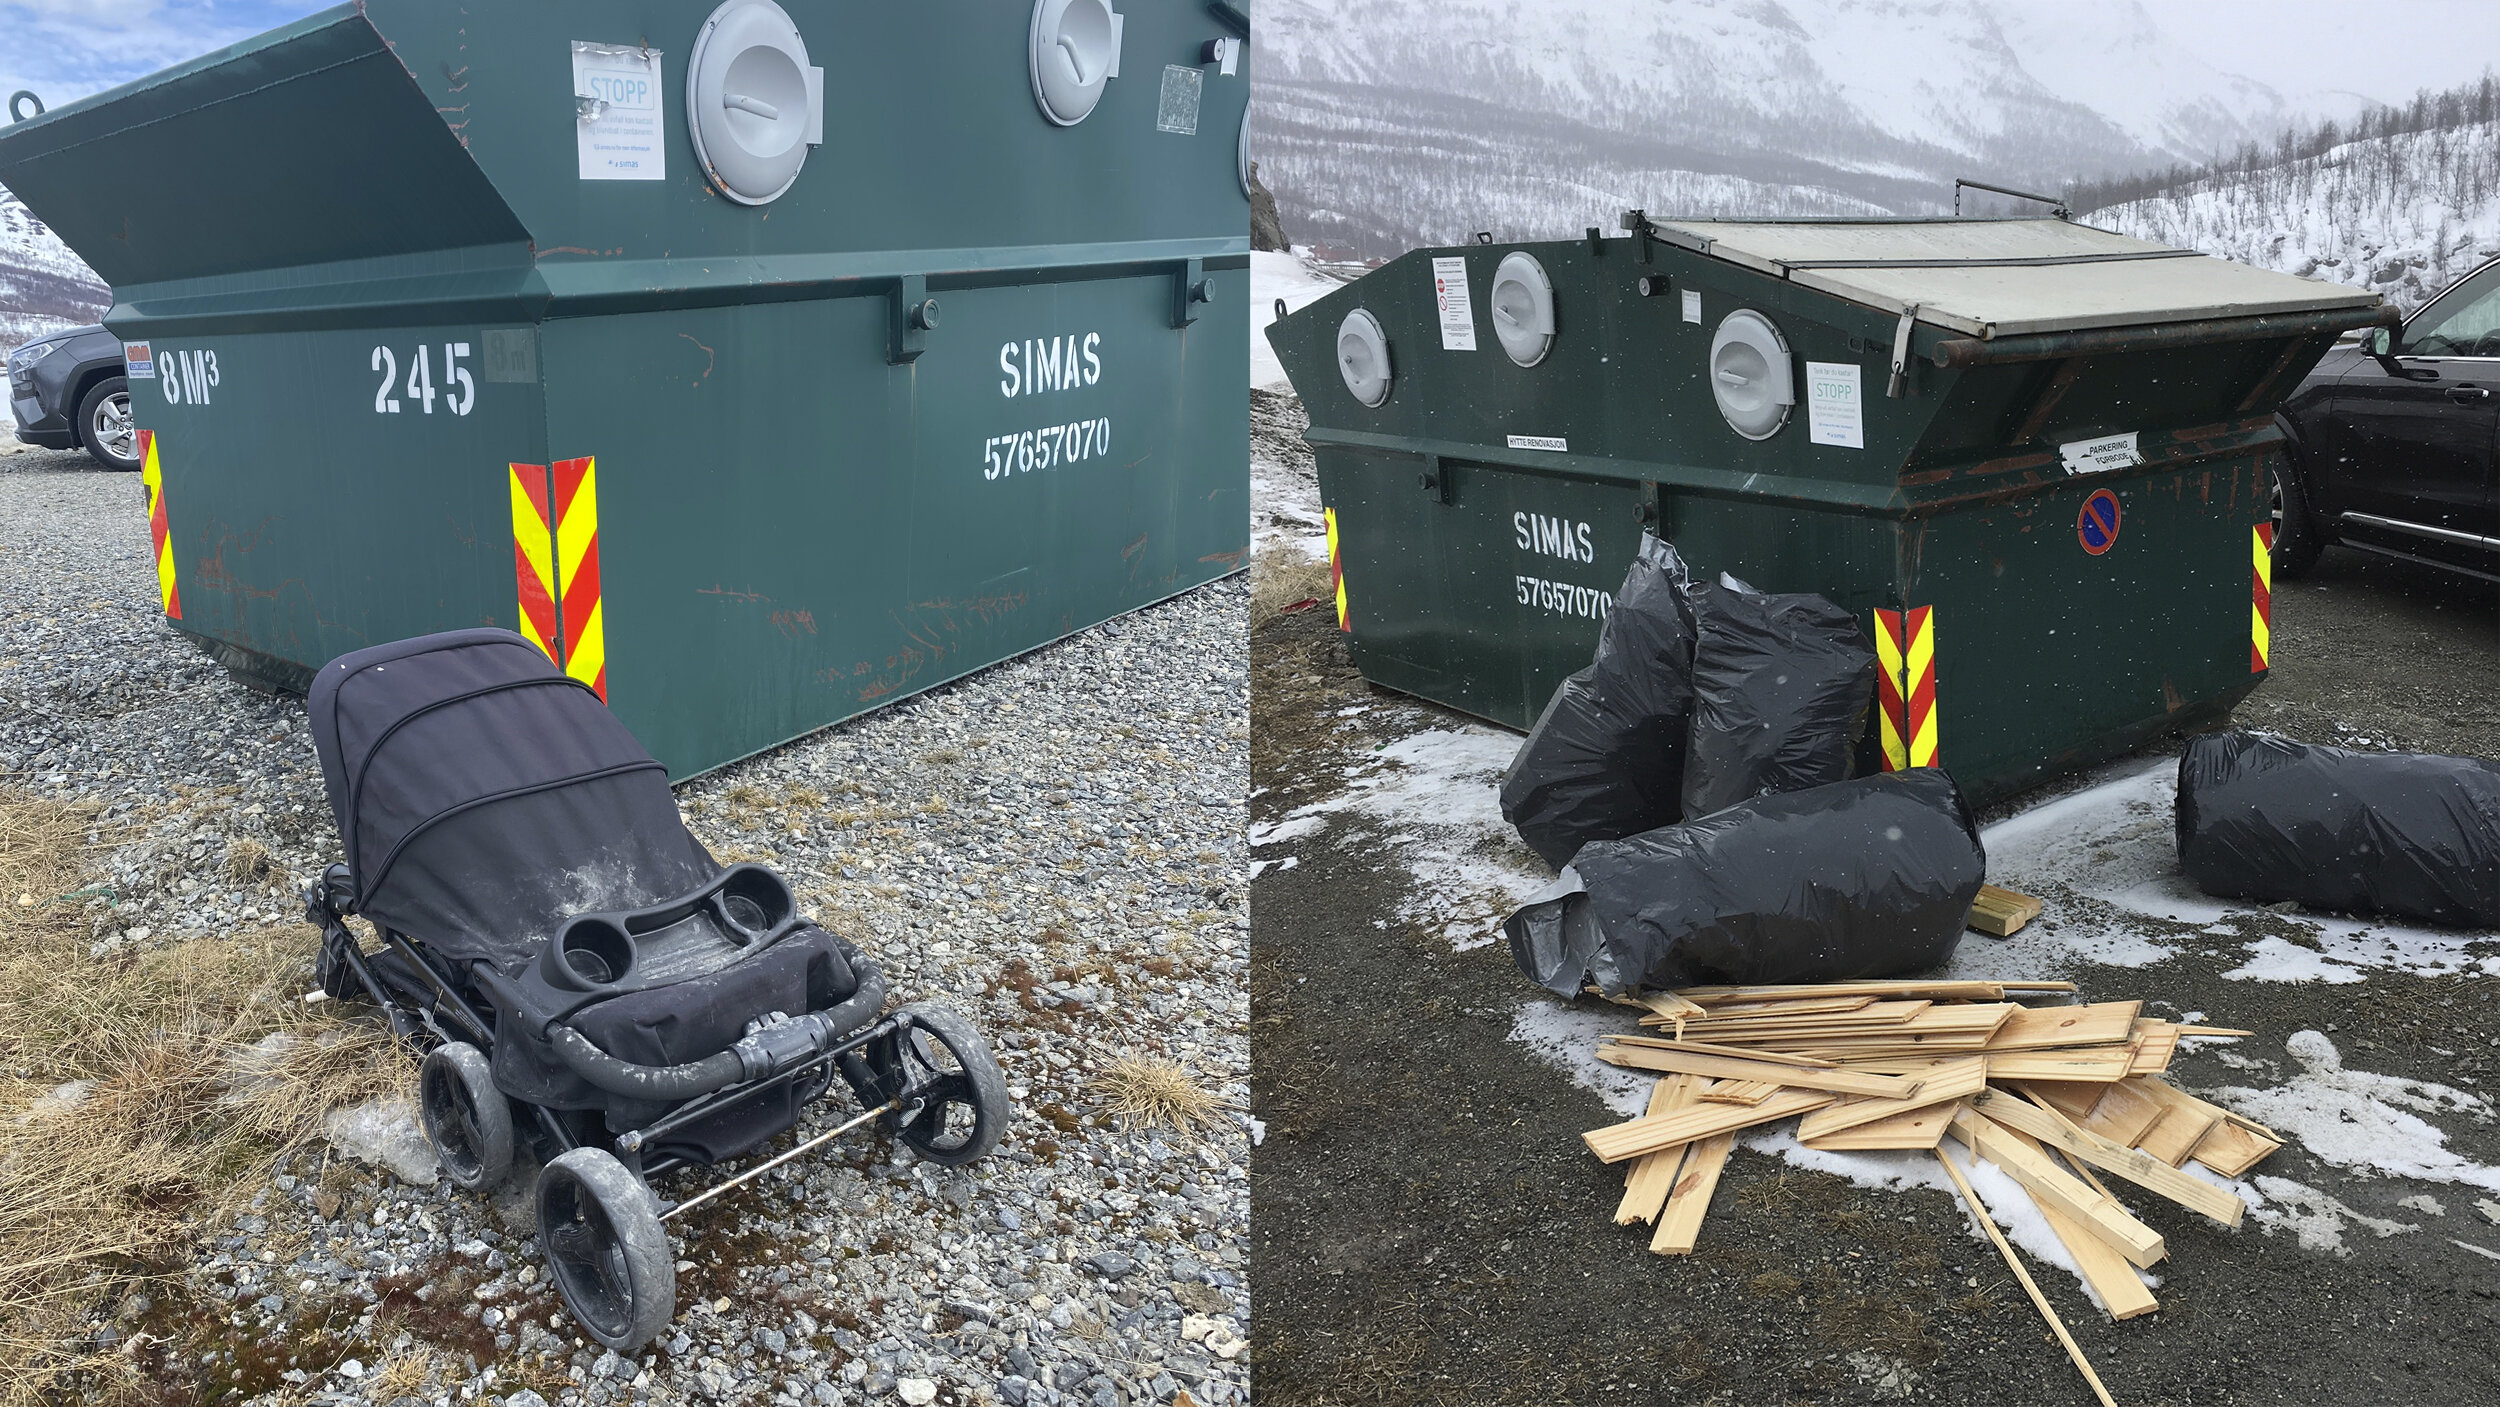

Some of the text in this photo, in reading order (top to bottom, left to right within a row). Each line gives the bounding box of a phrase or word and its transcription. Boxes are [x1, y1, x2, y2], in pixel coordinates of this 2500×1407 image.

[591, 77, 648, 105] STOPP
[371, 342, 475, 416] 245
[1000, 332, 1102, 399] SIMAS
[1816, 382, 1852, 399] STOPP
[984, 416, 1111, 481] 57657070
[1509, 437, 1566, 449] HYTTE RENOVASJON
[2089, 440, 2128, 455] PARKERING
[1513, 511, 1594, 564] SIMAS
[1516, 575, 1613, 620] 57657070
